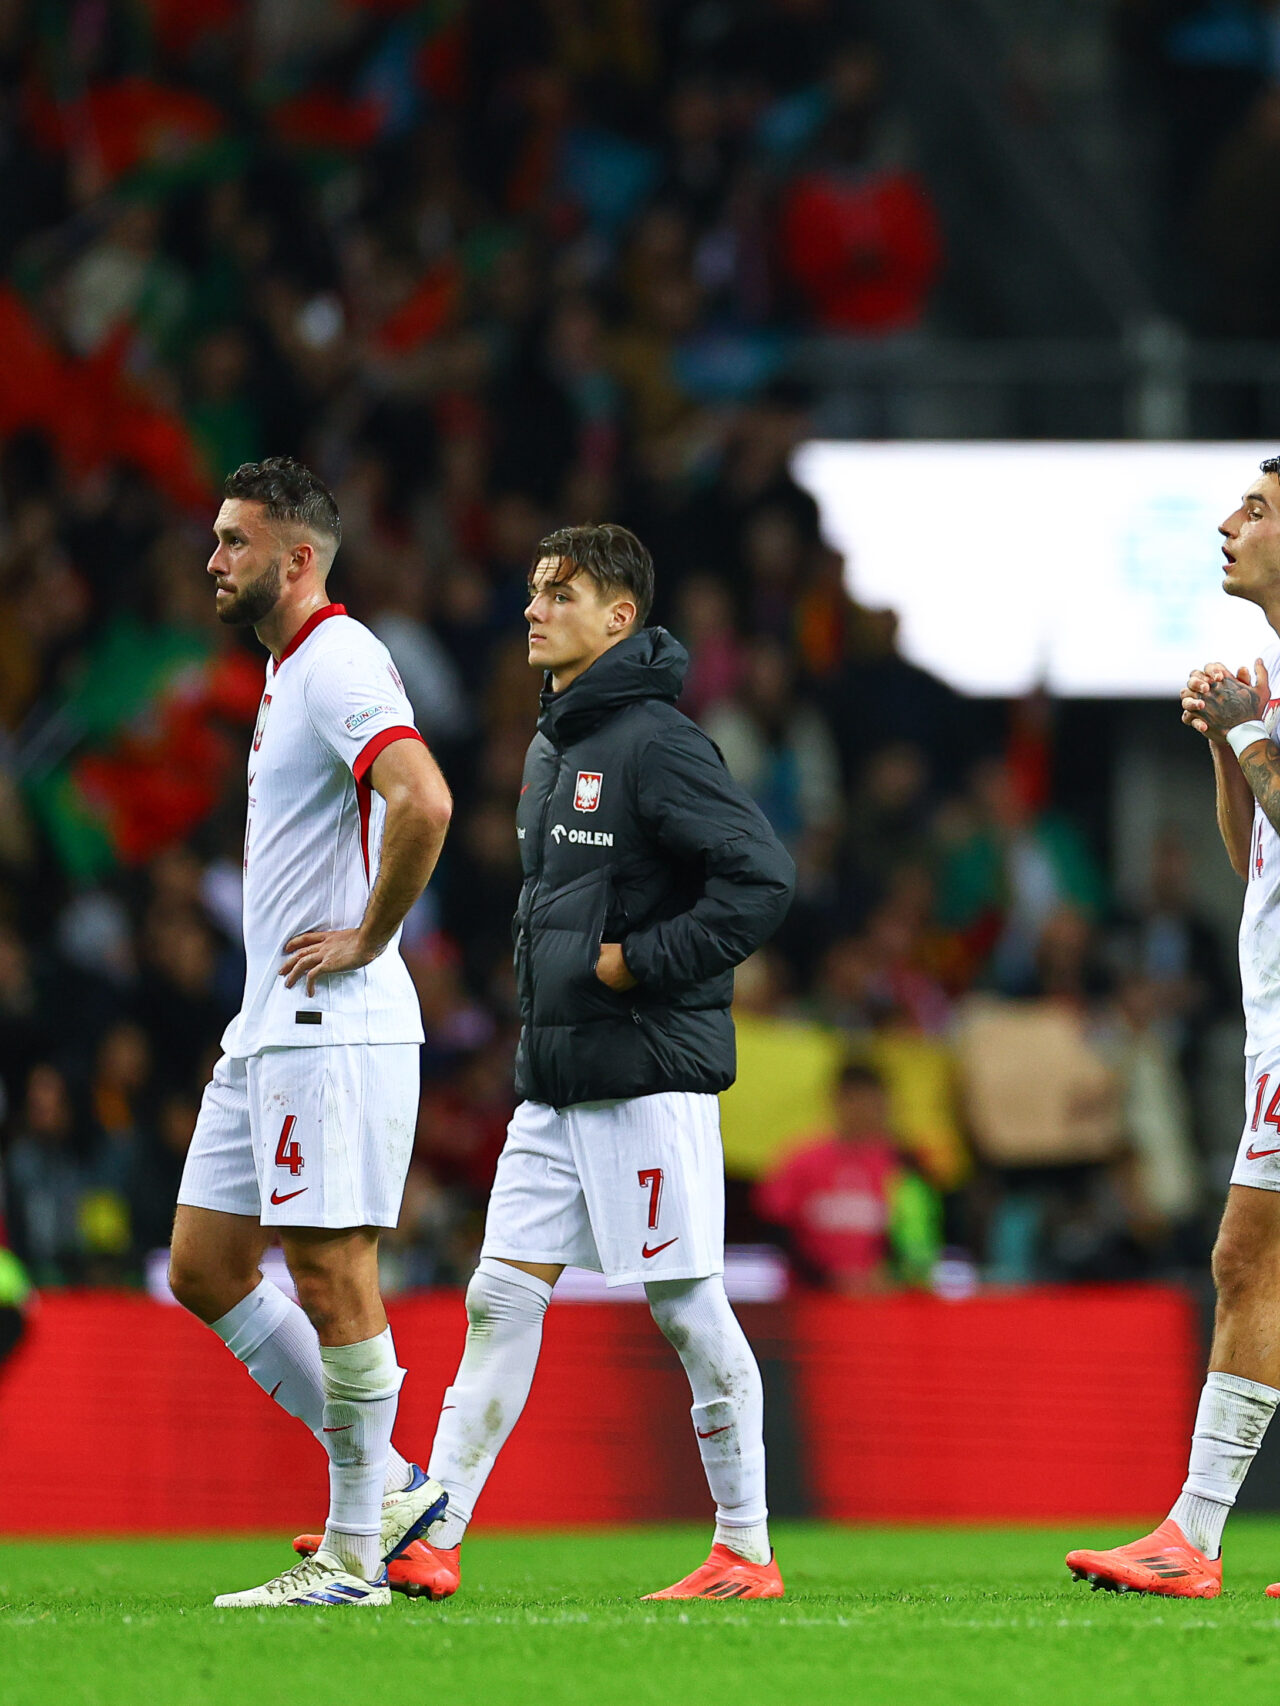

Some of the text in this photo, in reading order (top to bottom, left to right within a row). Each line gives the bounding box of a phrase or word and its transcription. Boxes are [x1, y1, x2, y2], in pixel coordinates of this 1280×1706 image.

[568, 829, 614, 847] ORLEN
[275, 1115, 305, 1177] 4
[637, 1168, 664, 1230] 7
